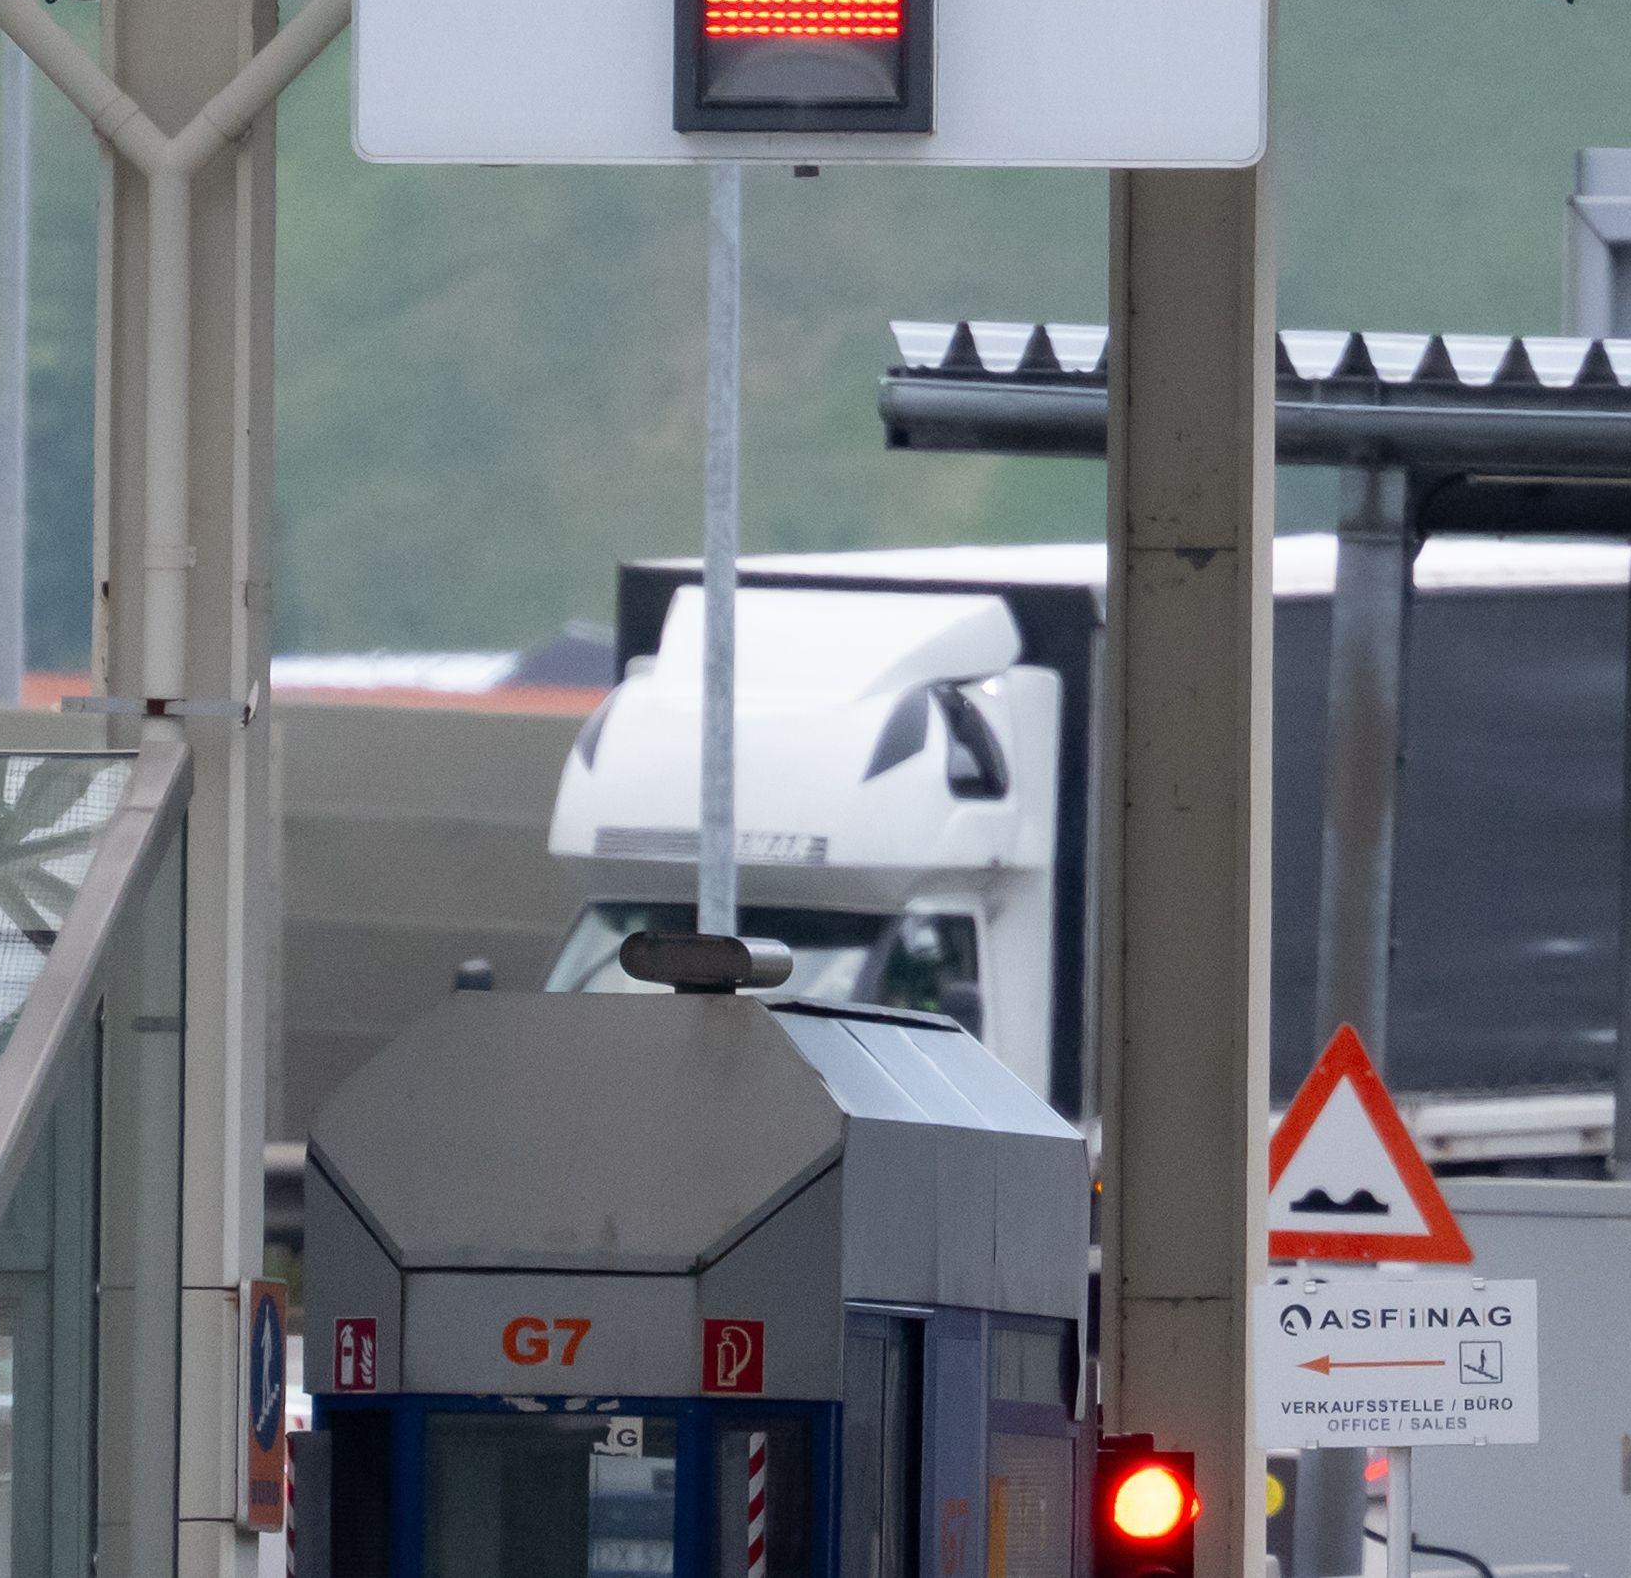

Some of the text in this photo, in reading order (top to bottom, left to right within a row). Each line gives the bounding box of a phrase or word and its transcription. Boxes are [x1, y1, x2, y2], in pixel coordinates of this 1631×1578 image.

[1319, 1306, 1512, 1330] ASFiNAG
[502, 1317, 592, 1366] G7
[1281, 1399, 1444, 1415] VERKAUFSSTELLE
[1464, 1396, 1513, 1411] BÜRO
[1327, 1418, 1391, 1432] OFFICE
[1410, 1416, 1468, 1431] SALES
